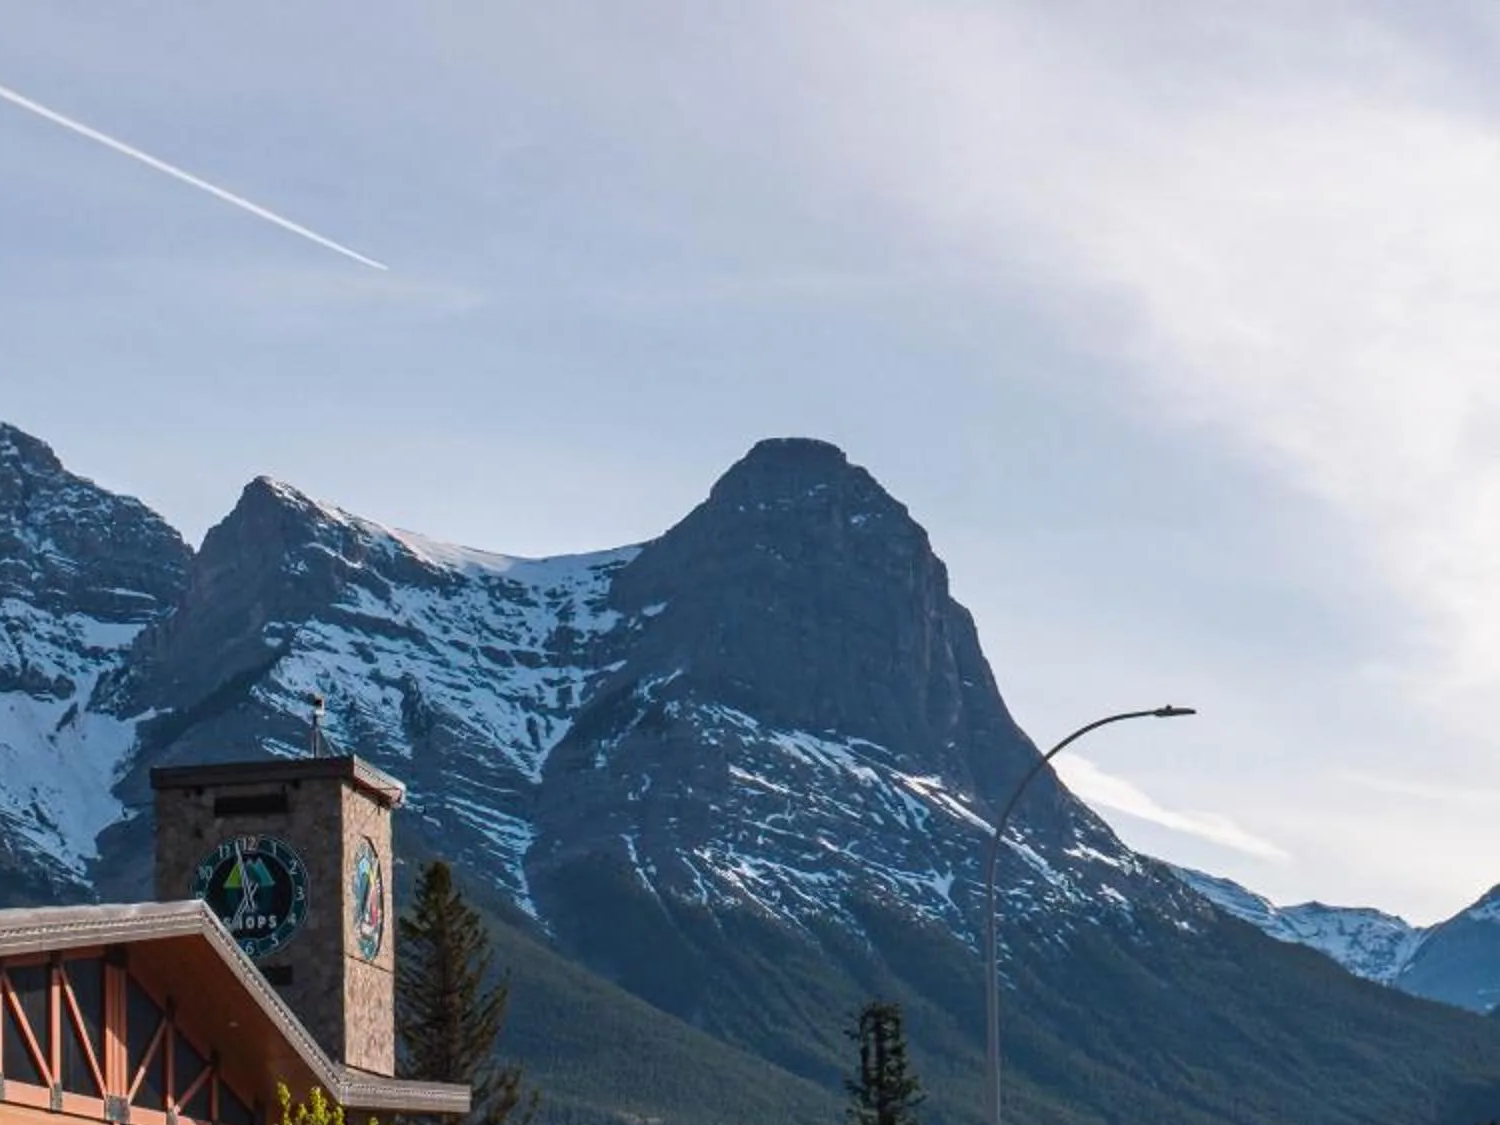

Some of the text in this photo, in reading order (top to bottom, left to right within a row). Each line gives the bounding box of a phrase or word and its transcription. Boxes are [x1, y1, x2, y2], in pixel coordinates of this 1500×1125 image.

[243, 837, 258, 852] 12
[271, 842, 278, 855] 1
[290, 860, 299, 875] 2
[297, 886, 305, 900] 3
[223, 915, 277, 929] SHOPS
[270, 932, 279, 946] 5
[245, 942, 254, 955] 6
